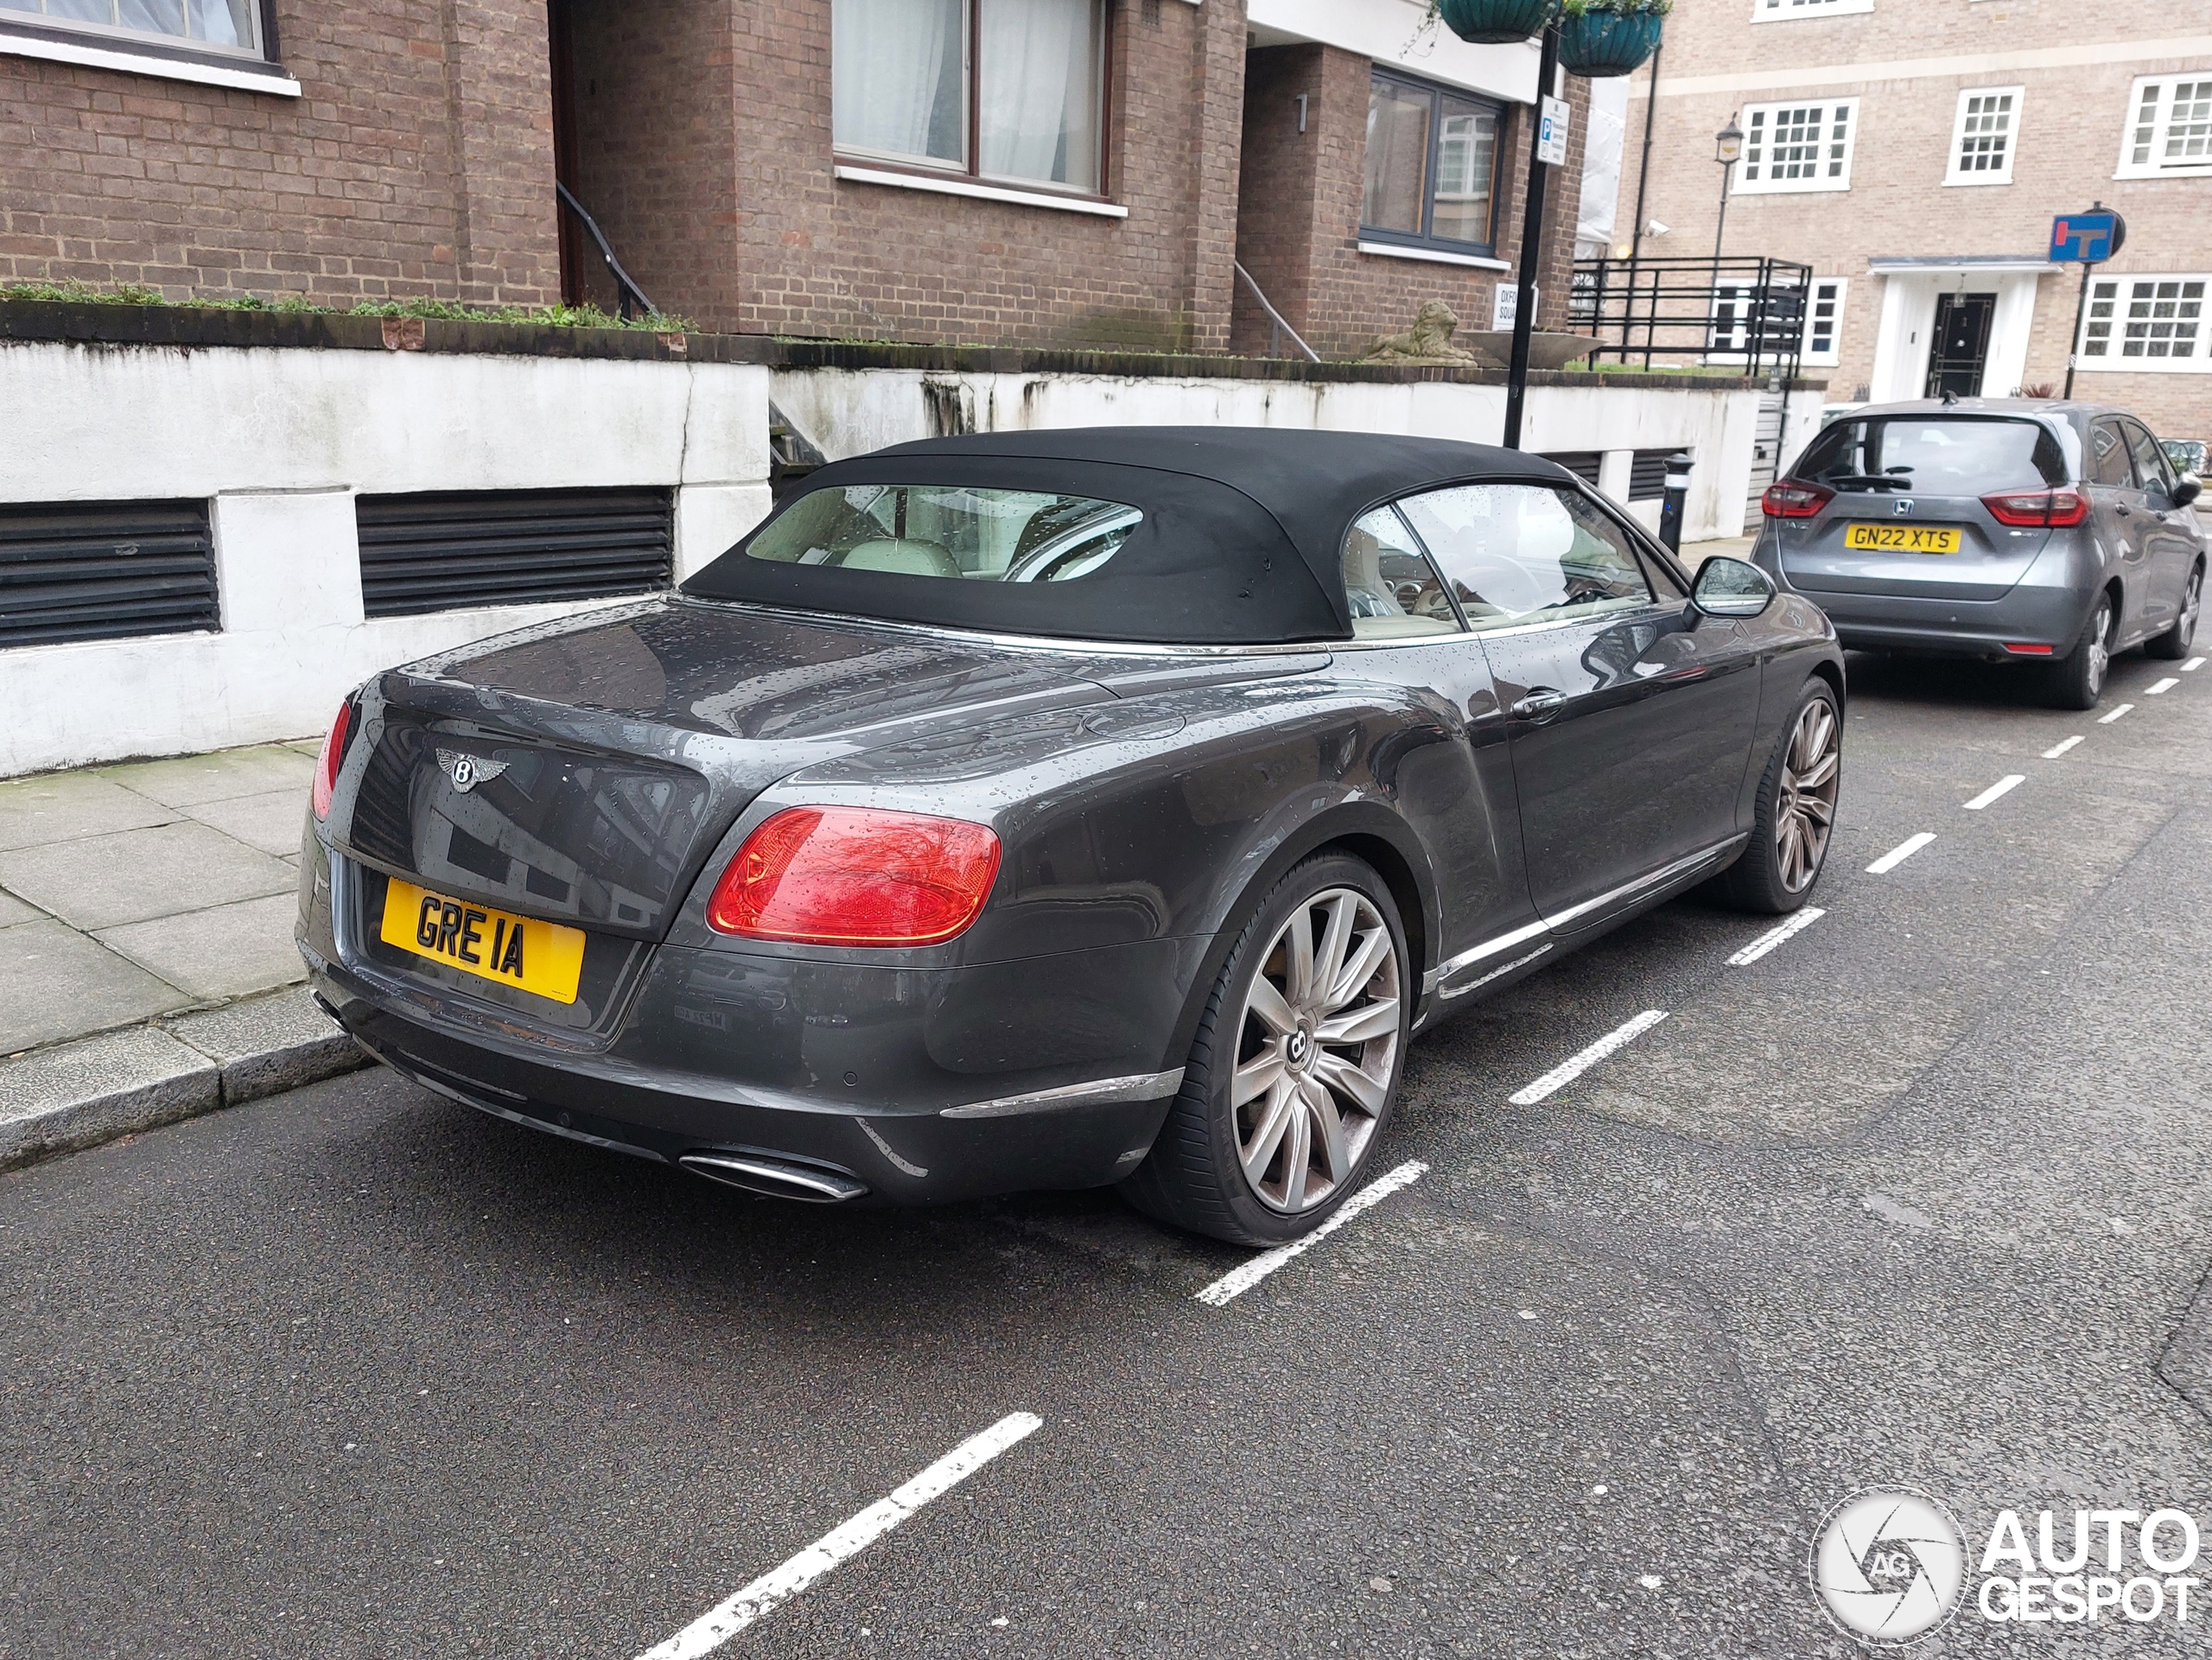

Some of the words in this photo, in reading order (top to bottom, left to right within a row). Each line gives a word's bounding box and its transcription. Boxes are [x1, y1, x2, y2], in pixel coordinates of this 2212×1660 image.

[1296, 93, 1308, 131] 1
[1543, 119, 1551, 138] P
[1501, 289, 1516, 303] OXFO
[1499, 306, 1516, 320] SQUA
[1854, 528, 1906, 546] GN22
[1910, 531, 1951, 549] XTS
[416, 895, 487, 964] GRE
